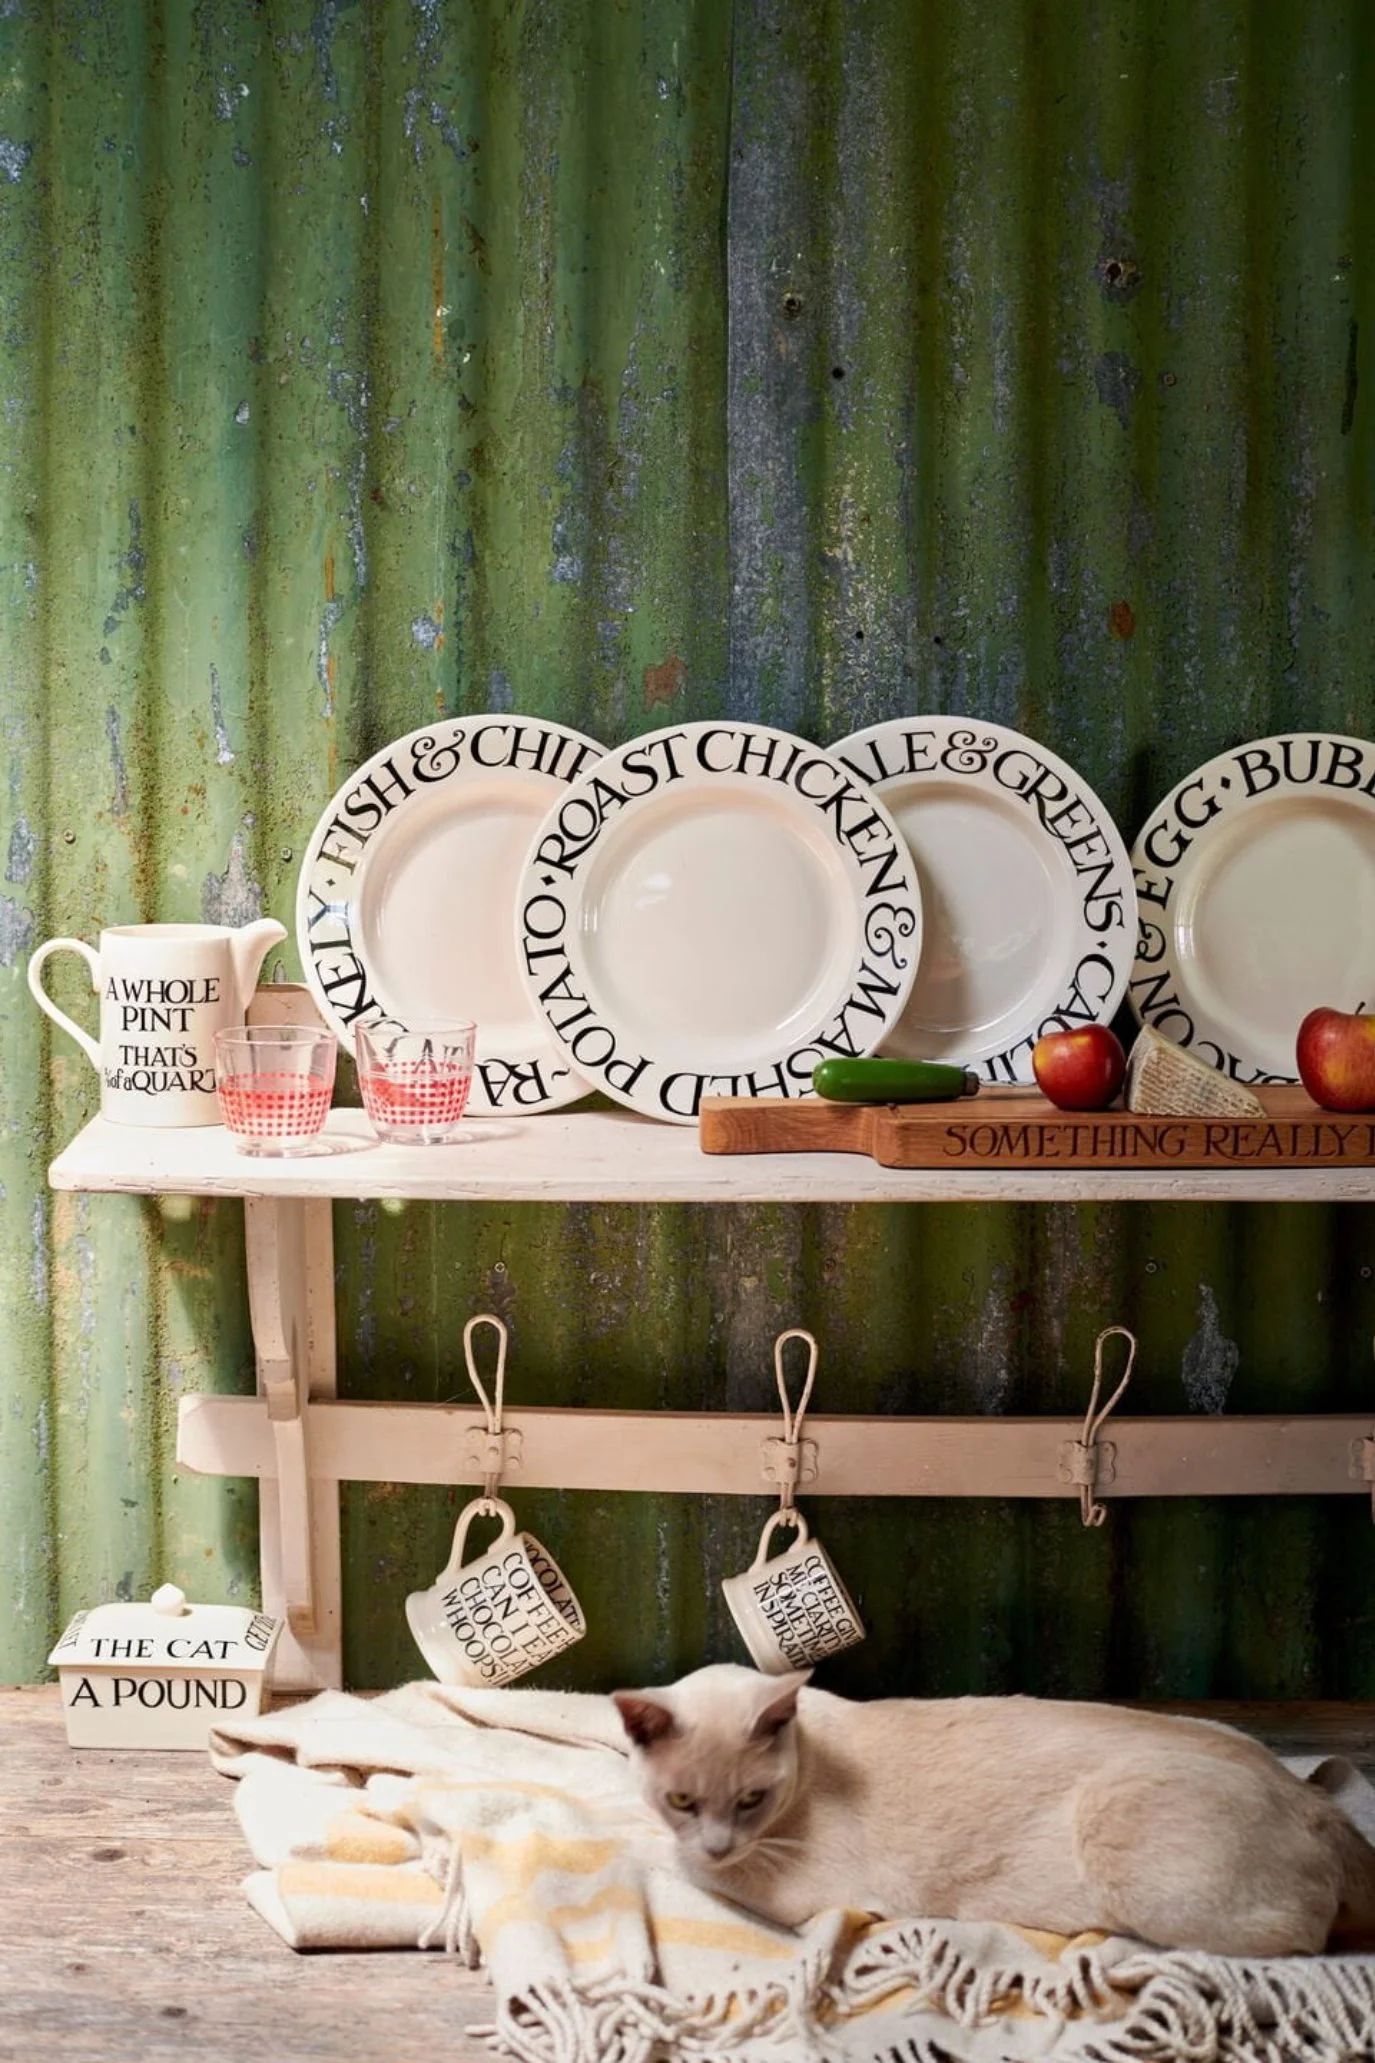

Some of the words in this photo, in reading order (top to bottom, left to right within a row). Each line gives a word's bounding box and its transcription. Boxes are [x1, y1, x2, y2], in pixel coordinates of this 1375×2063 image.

[315, 757, 416, 876] FISH
[409, 728, 467, 783] &
[533, 732, 688, 880] ROAST
[696, 729, 909, 898] CHICKEN
[940, 729, 999, 774] &
[992, 749, 1126, 932] GREENS
[1133, 776, 1223, 911] EGG
[864, 901, 917, 970] &
[106, 976, 119, 1002] A
[120, 977, 221, 1004] WHOLE
[121, 1005, 195, 1033] PINT
[522, 894, 655, 1097] POTATO
[118, 1043, 198, 1068] THAT'S
[1130, 971, 1300, 1084] ACON
[132, 1068, 217, 1096] QUART
[942, 1123, 1190, 1159] SOMETHING
[1203, 1123, 1360, 1161] REALLY
[481, 1565, 519, 1621] CAN
[511, 1622, 531, 1635] I
[503, 1552, 569, 1645] COFFEE
[804, 1555, 846, 1619] COFFEE
[90, 1638, 155, 1659] THE
[166, 1639, 239, 1660] CAT
[69, 1677, 103, 1709] A
[112, 1677, 248, 1710] POUND
